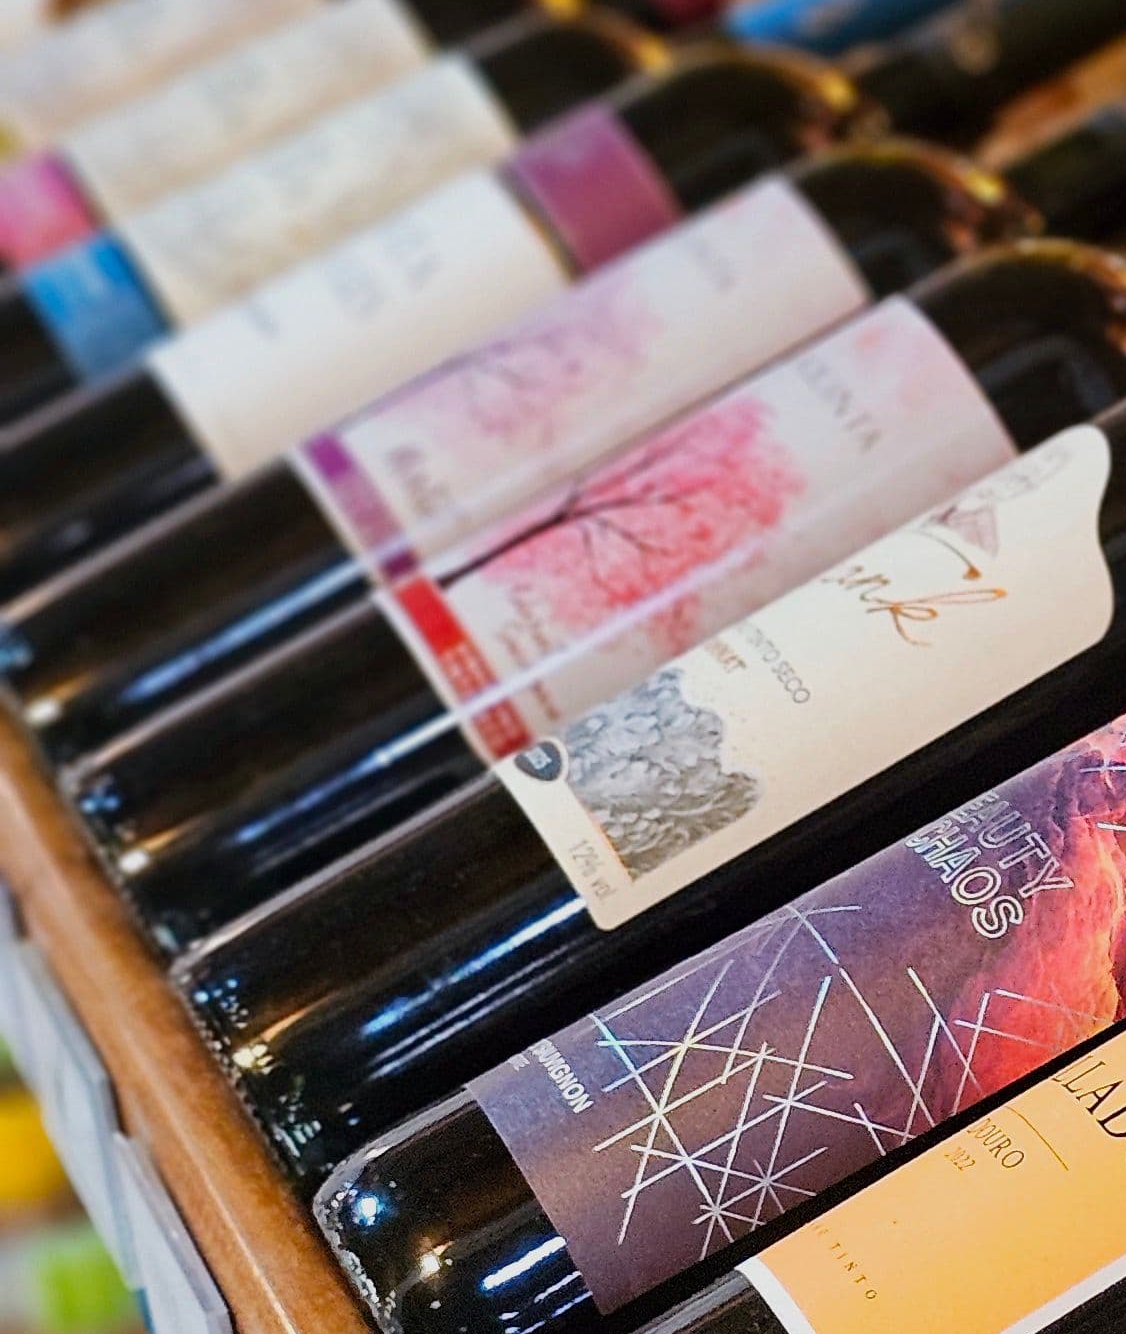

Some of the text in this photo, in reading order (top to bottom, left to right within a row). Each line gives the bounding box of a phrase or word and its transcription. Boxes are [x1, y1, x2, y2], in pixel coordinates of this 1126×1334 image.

[771, 660, 811, 704] SECO
[950, 789, 1075, 899] EAUTY
[966, 1117, 1025, 1169] DOURO
